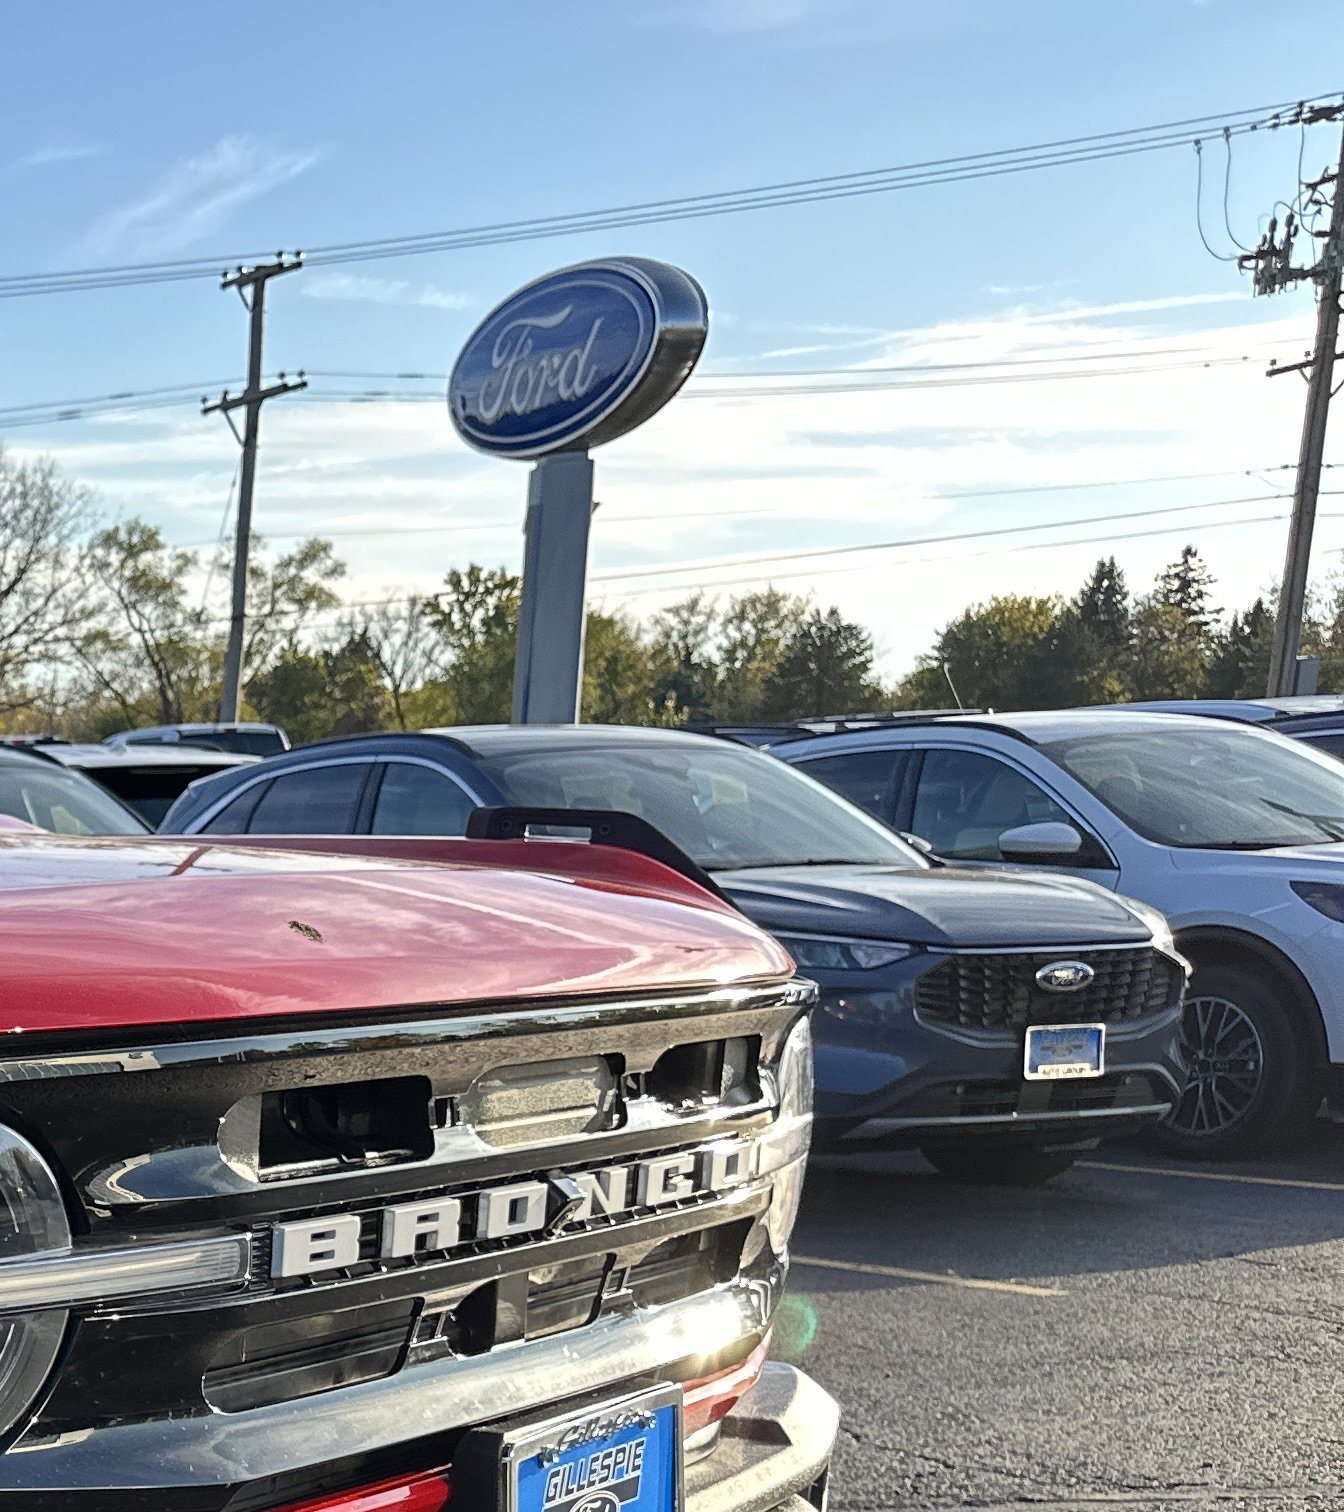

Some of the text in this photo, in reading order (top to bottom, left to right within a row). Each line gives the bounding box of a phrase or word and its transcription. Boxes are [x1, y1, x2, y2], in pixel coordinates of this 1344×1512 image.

[479, 304, 604, 424] Ford
[272, 1139, 754, 1278] BRONCO
[544, 1438, 646, 1504] GILLESPIE
